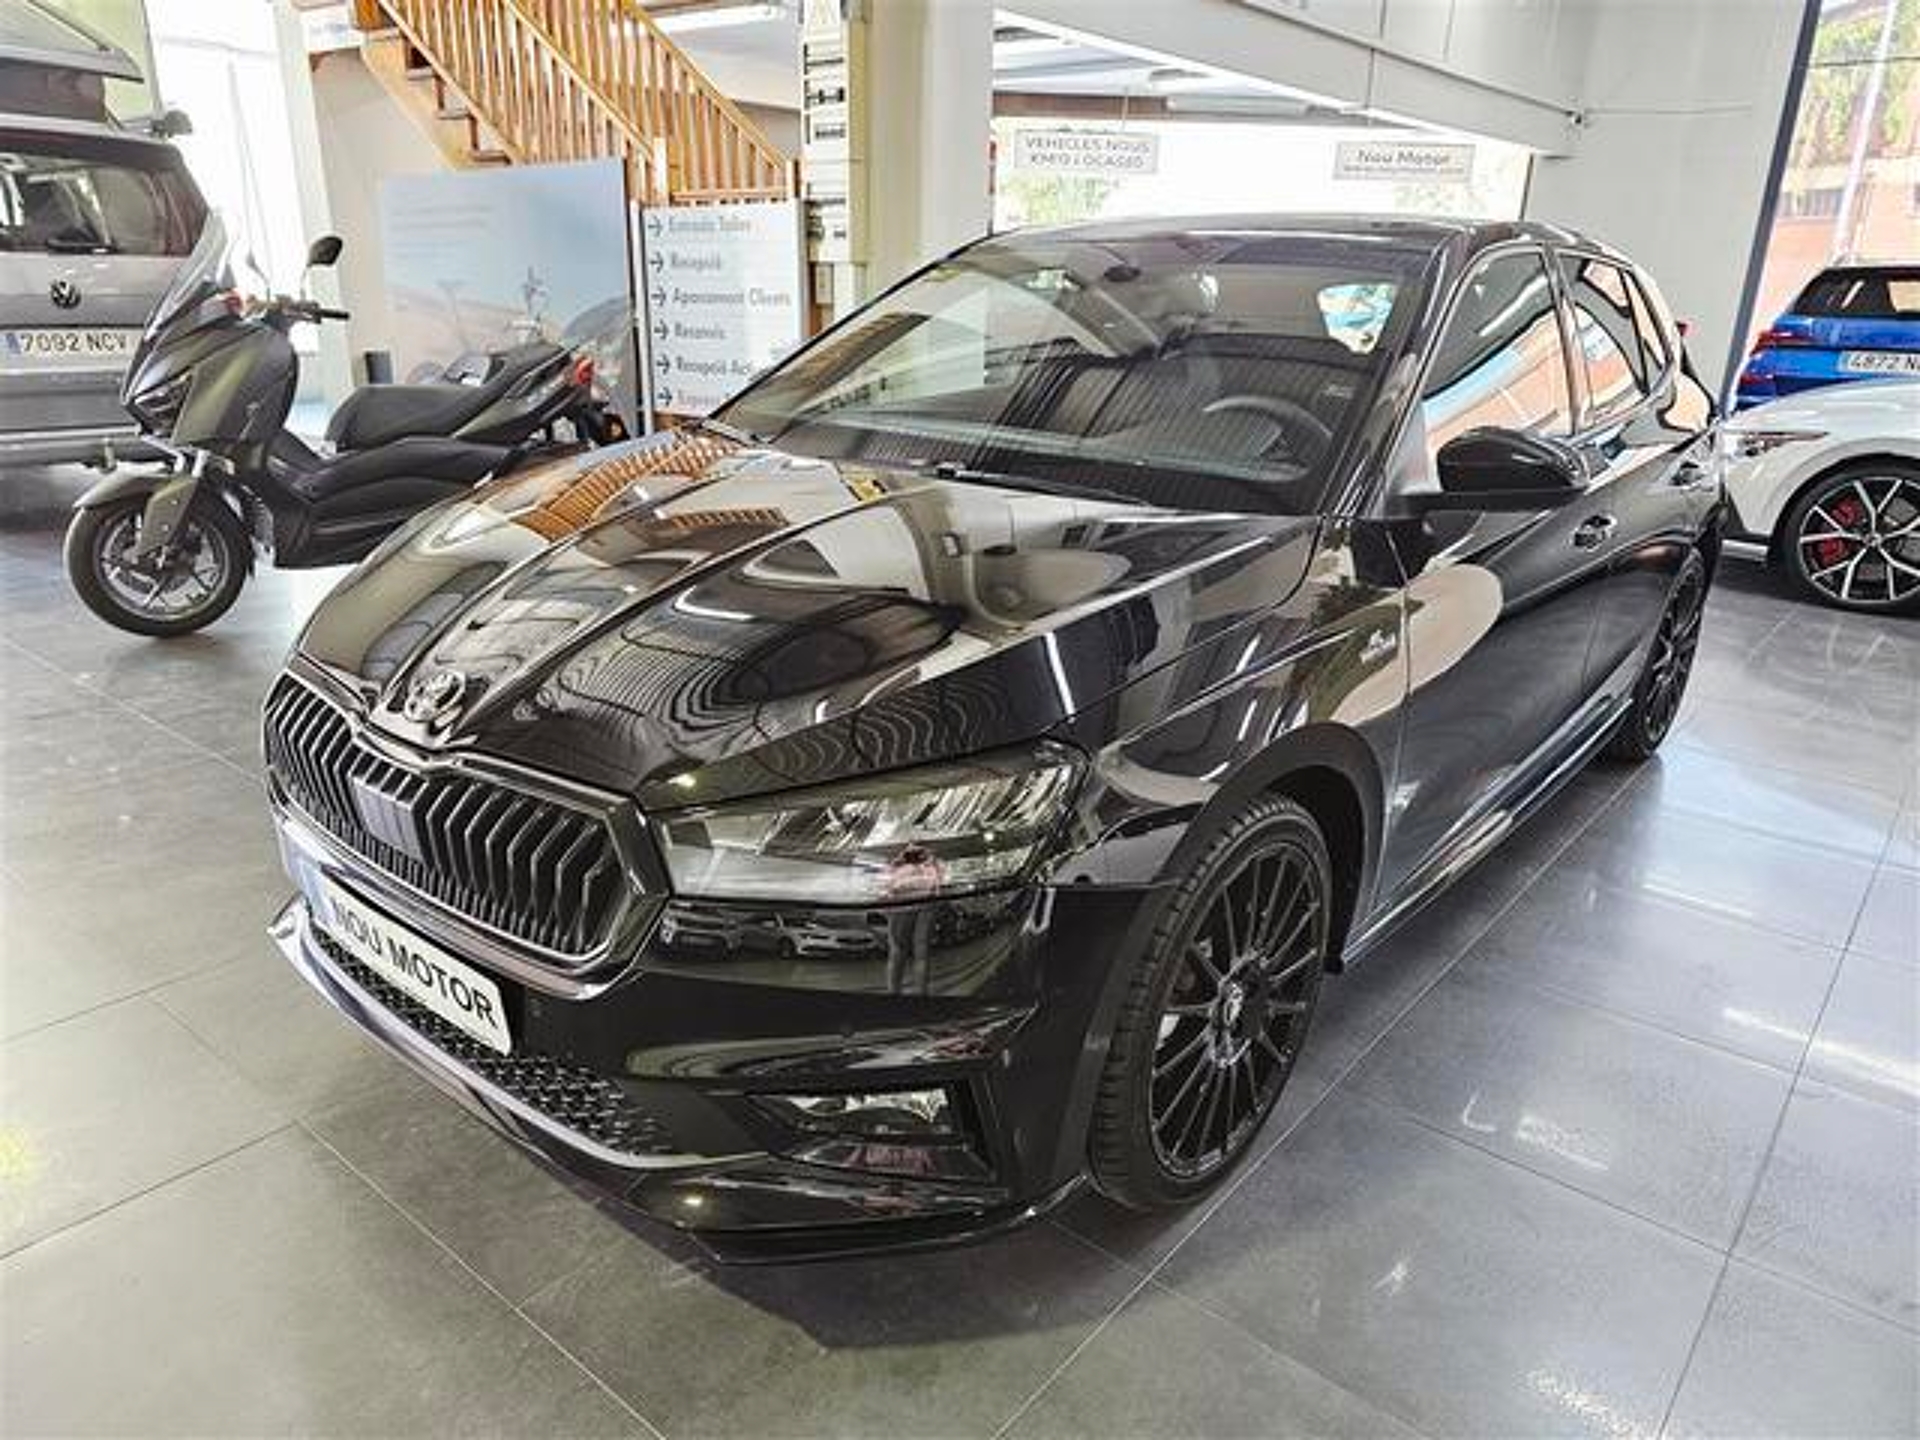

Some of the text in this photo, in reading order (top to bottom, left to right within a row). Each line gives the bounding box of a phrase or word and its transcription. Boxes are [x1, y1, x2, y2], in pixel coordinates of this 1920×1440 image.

[1358, 150, 1450, 166] Nou Motor
[387, 936, 499, 1029] MOTOR
